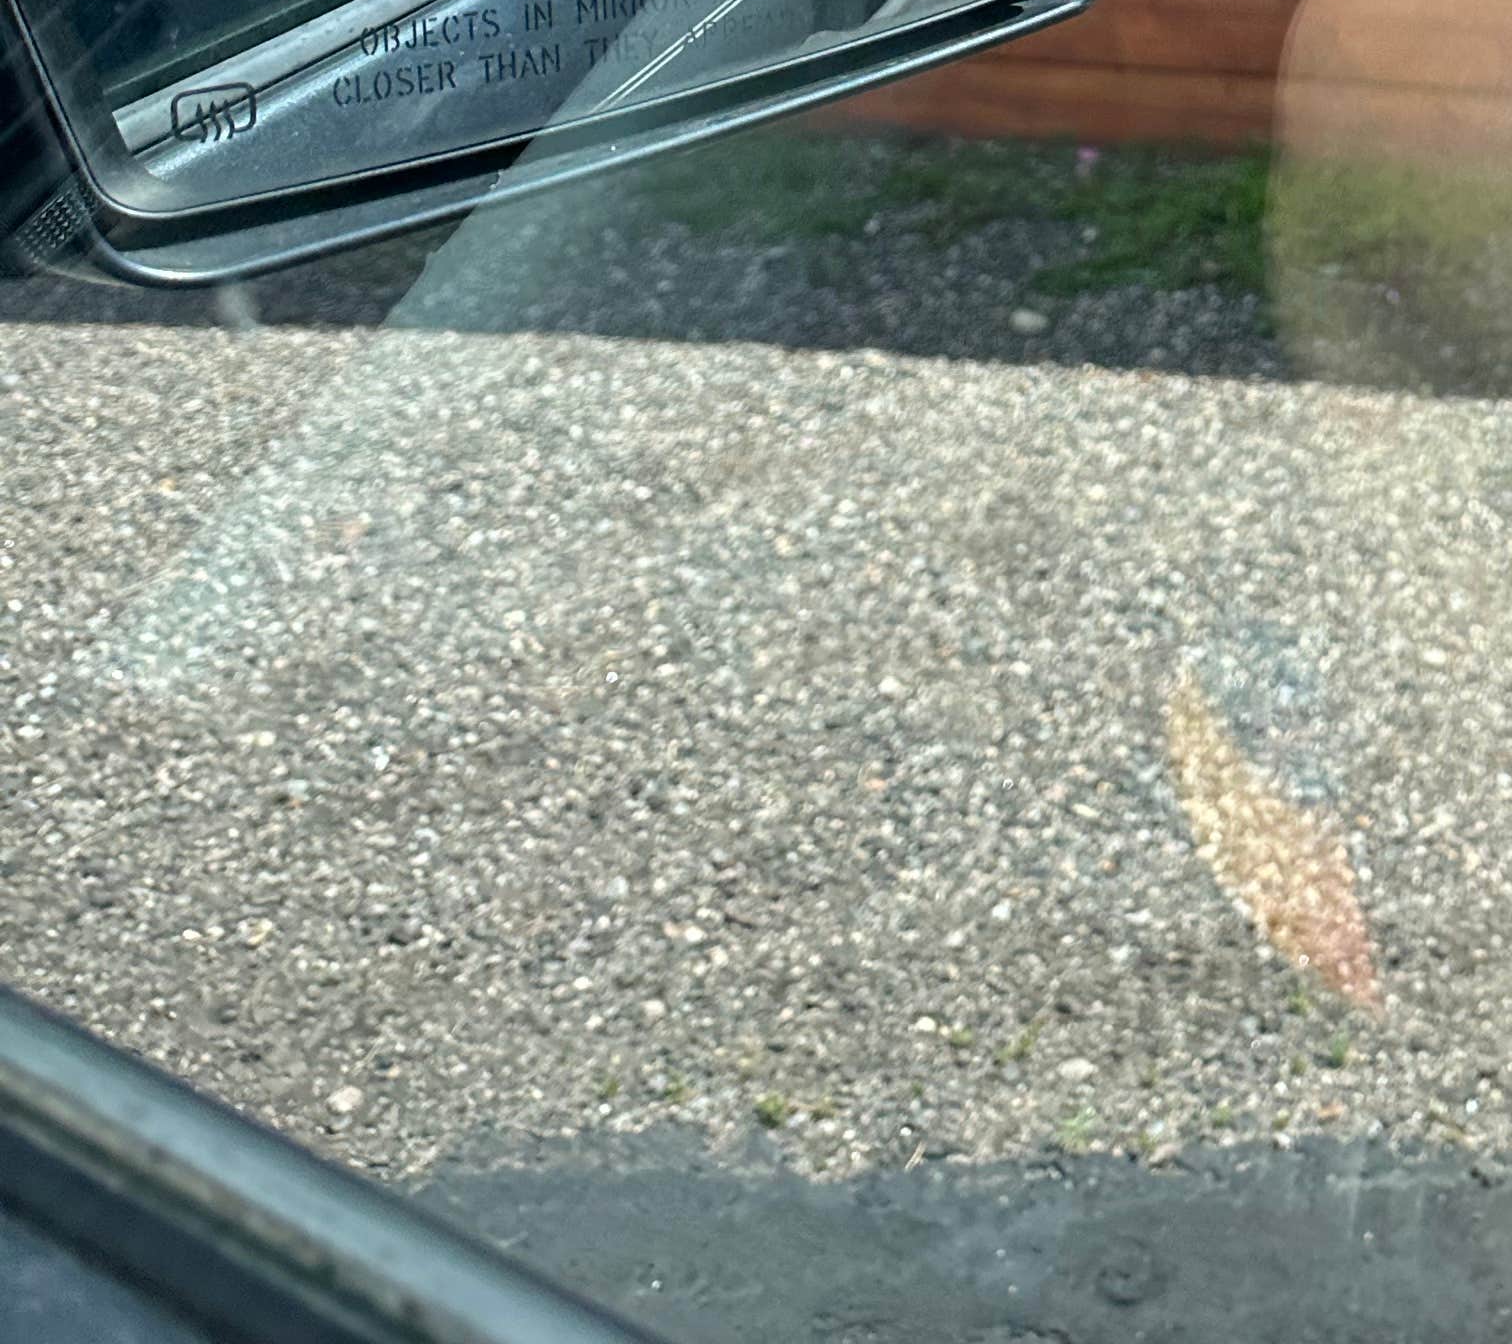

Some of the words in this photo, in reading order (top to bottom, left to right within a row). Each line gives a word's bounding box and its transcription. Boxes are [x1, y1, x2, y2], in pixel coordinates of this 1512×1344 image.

[360, 9, 500, 56] OBJECTS
[525, 0, 553, 32] IN
[333, 60, 457, 106] CLOSER
[479, 44, 561, 84] THAN
[584, 28, 658, 65] THEY
